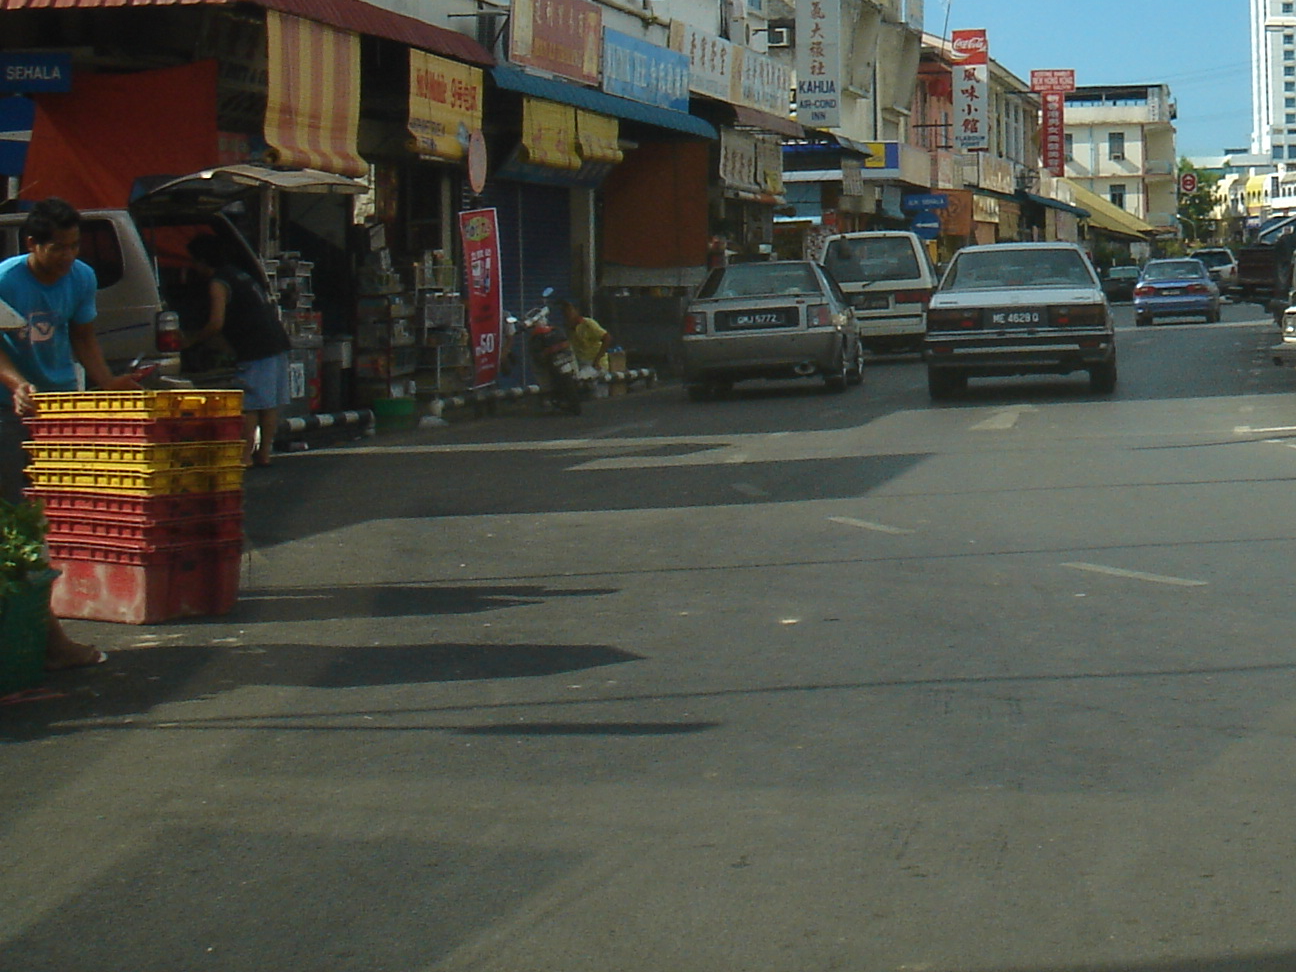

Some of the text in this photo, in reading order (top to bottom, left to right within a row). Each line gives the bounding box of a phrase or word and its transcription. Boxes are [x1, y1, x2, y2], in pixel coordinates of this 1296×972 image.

[6, 66, 61, 80] SEHALA
[799, 80, 836, 95] KAHUA
[799, 99, 837, 110] AIR-COND
[811, 111, 826, 121] INN
